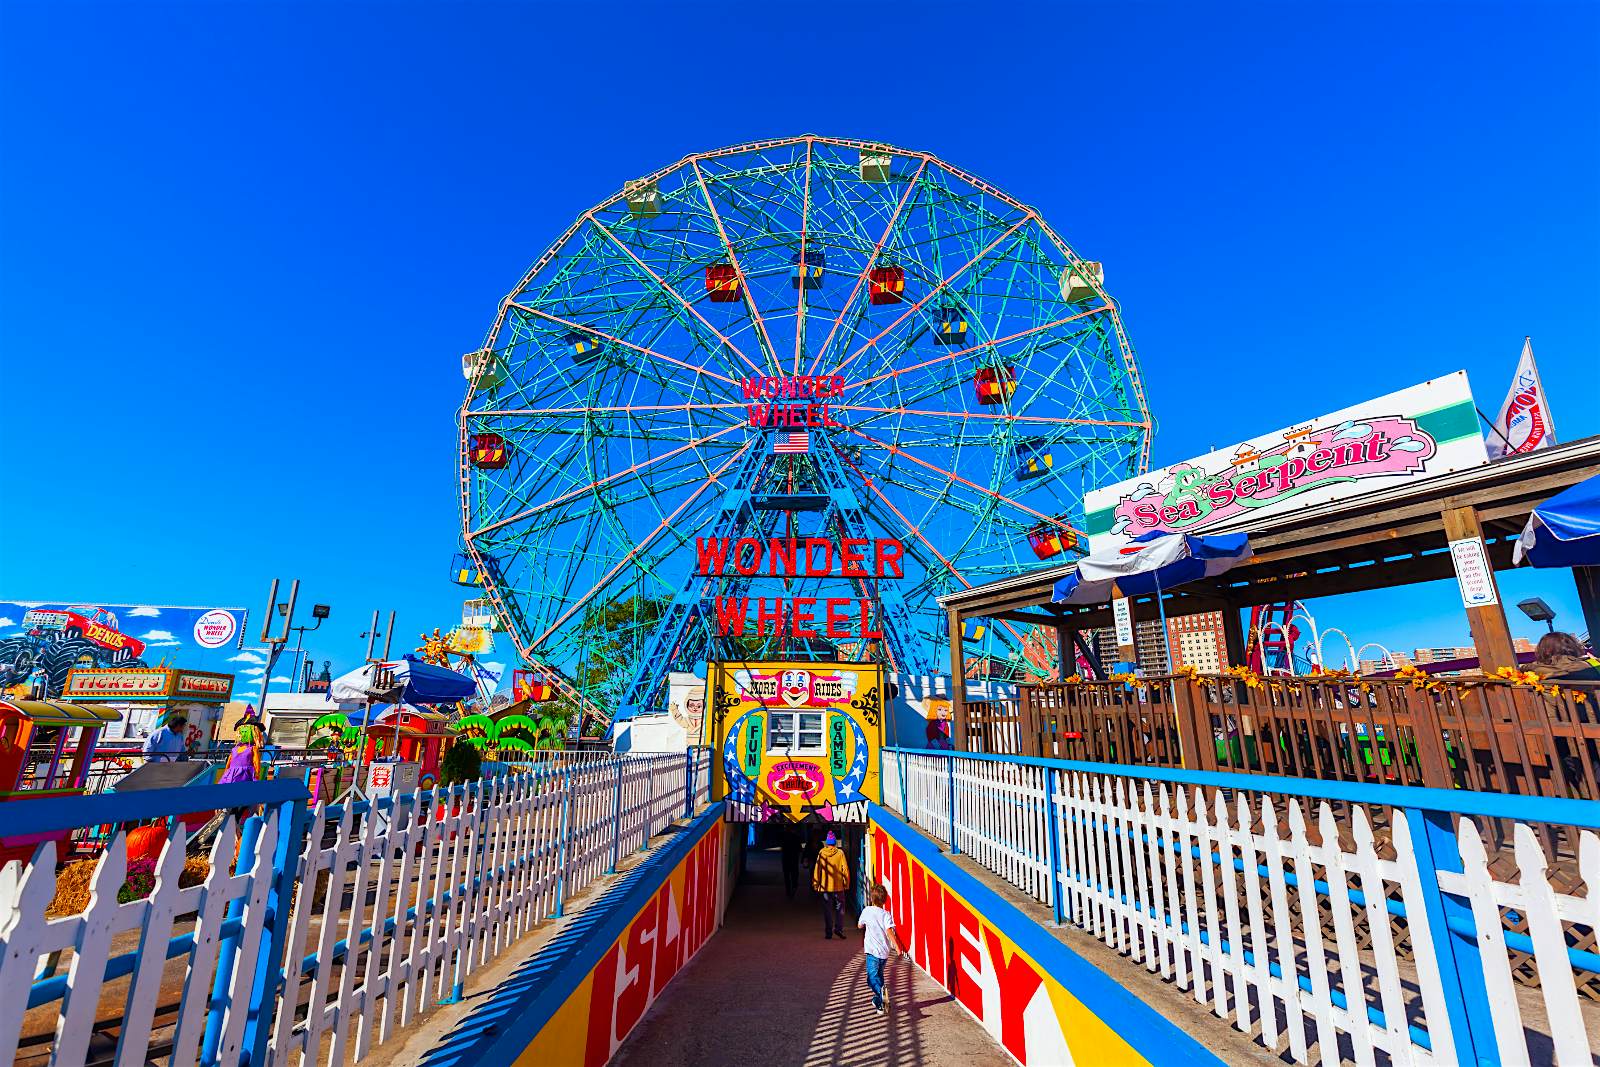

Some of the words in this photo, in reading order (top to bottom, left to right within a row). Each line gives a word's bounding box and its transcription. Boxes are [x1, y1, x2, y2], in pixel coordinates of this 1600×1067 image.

[741, 375, 845, 399] WONDER
[747, 403, 839, 428] WHEEL
[1133, 498, 1201, 530] Sea
[1206, 430, 1389, 510] Serpent
[696, 537, 904, 577] WONDER
[715, 595, 883, 639] WHEEL
[76, 675, 161, 690] TICKETS
[180, 677, 229, 692] TICKETS
[750, 681, 777, 696] MORE
[814, 681, 842, 697] RIDES
[748, 725, 759, 767] FUN
[833, 721, 843, 770] GAMES
[776, 762, 818, 772] EXCITEMENT
[781, 780, 810, 791] THRILLS
[725, 799, 763, 823] THIS
[831, 799, 869, 824] WAY
[584, 820, 721, 1067] ISLAND
[873, 824, 1045, 1067] CONEY
